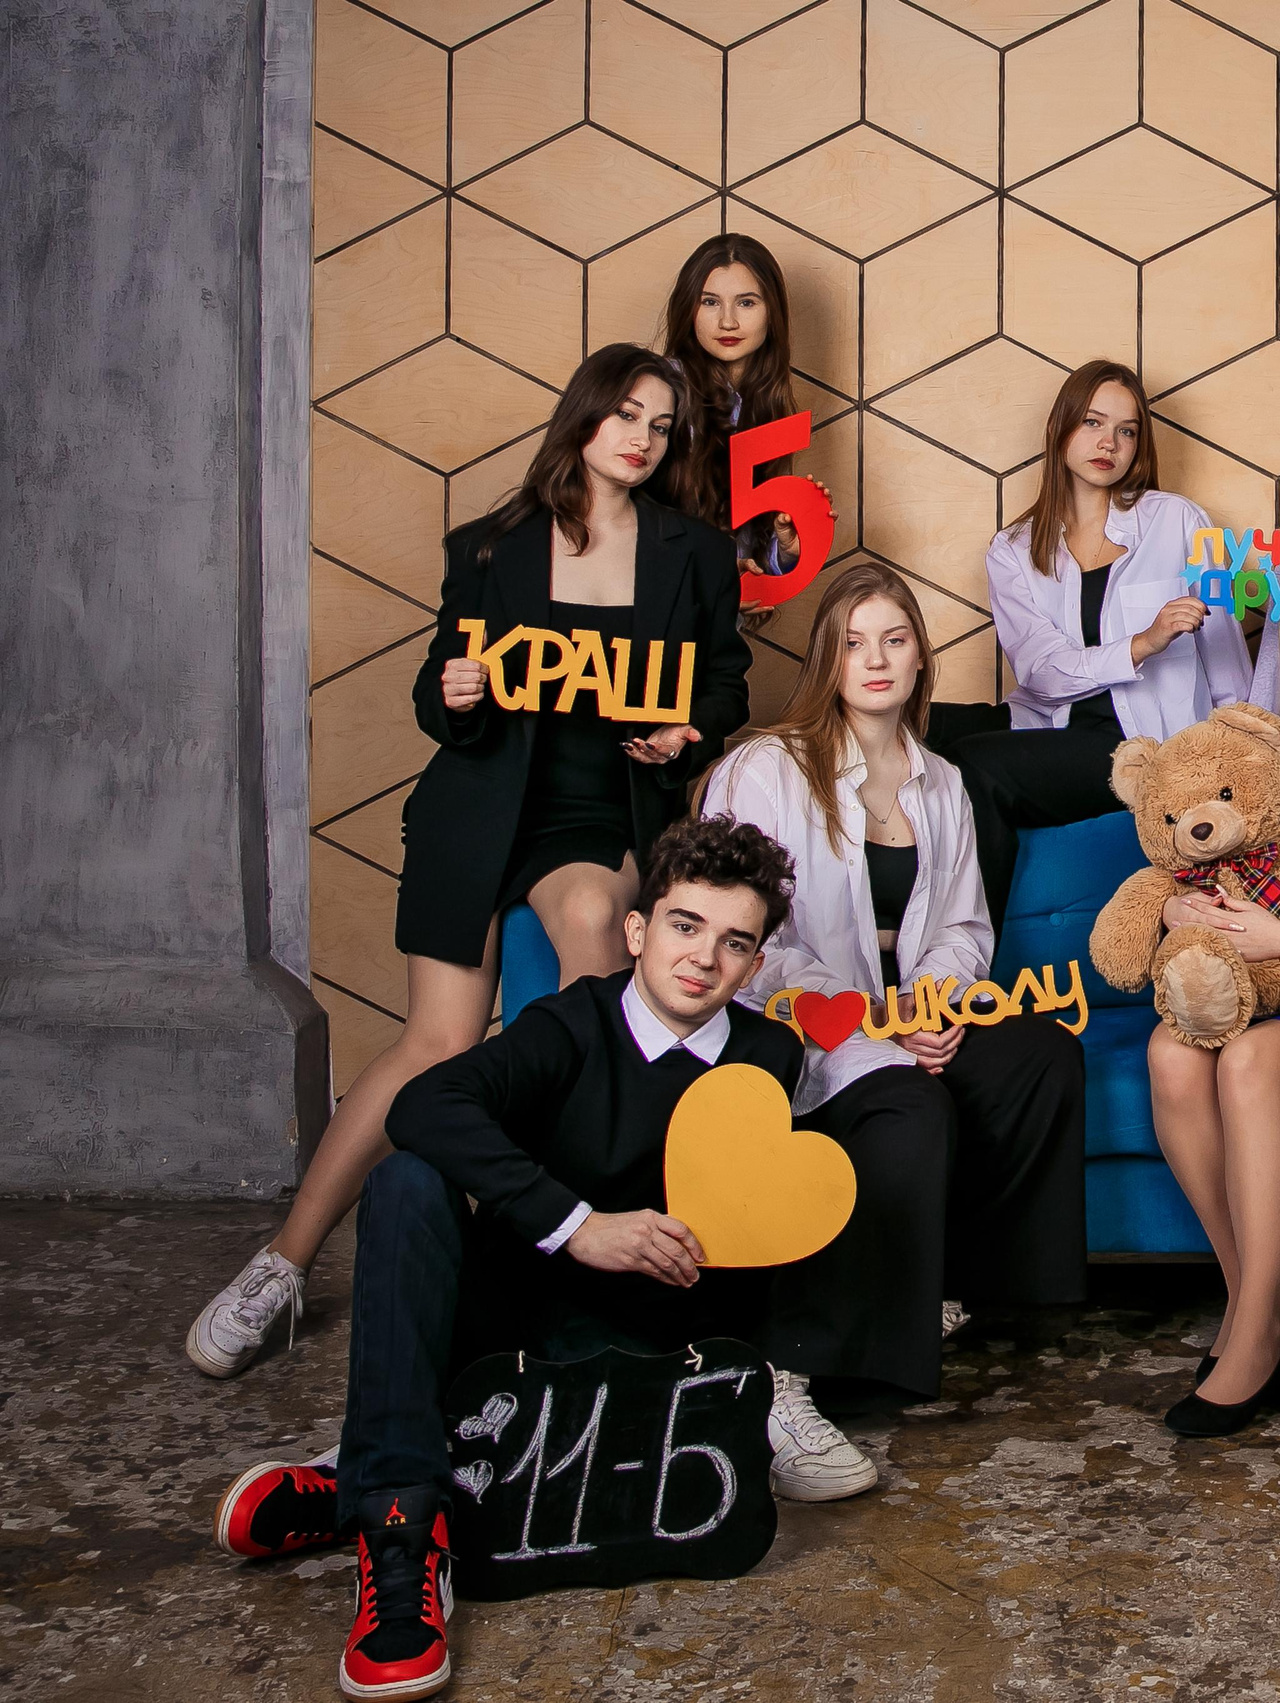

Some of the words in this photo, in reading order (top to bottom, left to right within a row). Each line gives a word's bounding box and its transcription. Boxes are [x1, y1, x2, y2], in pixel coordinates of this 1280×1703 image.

[730, 410, 835, 607] 5
[457, 618, 696, 724] КРАШ
[492, 1368, 757, 1562] 11-Б
